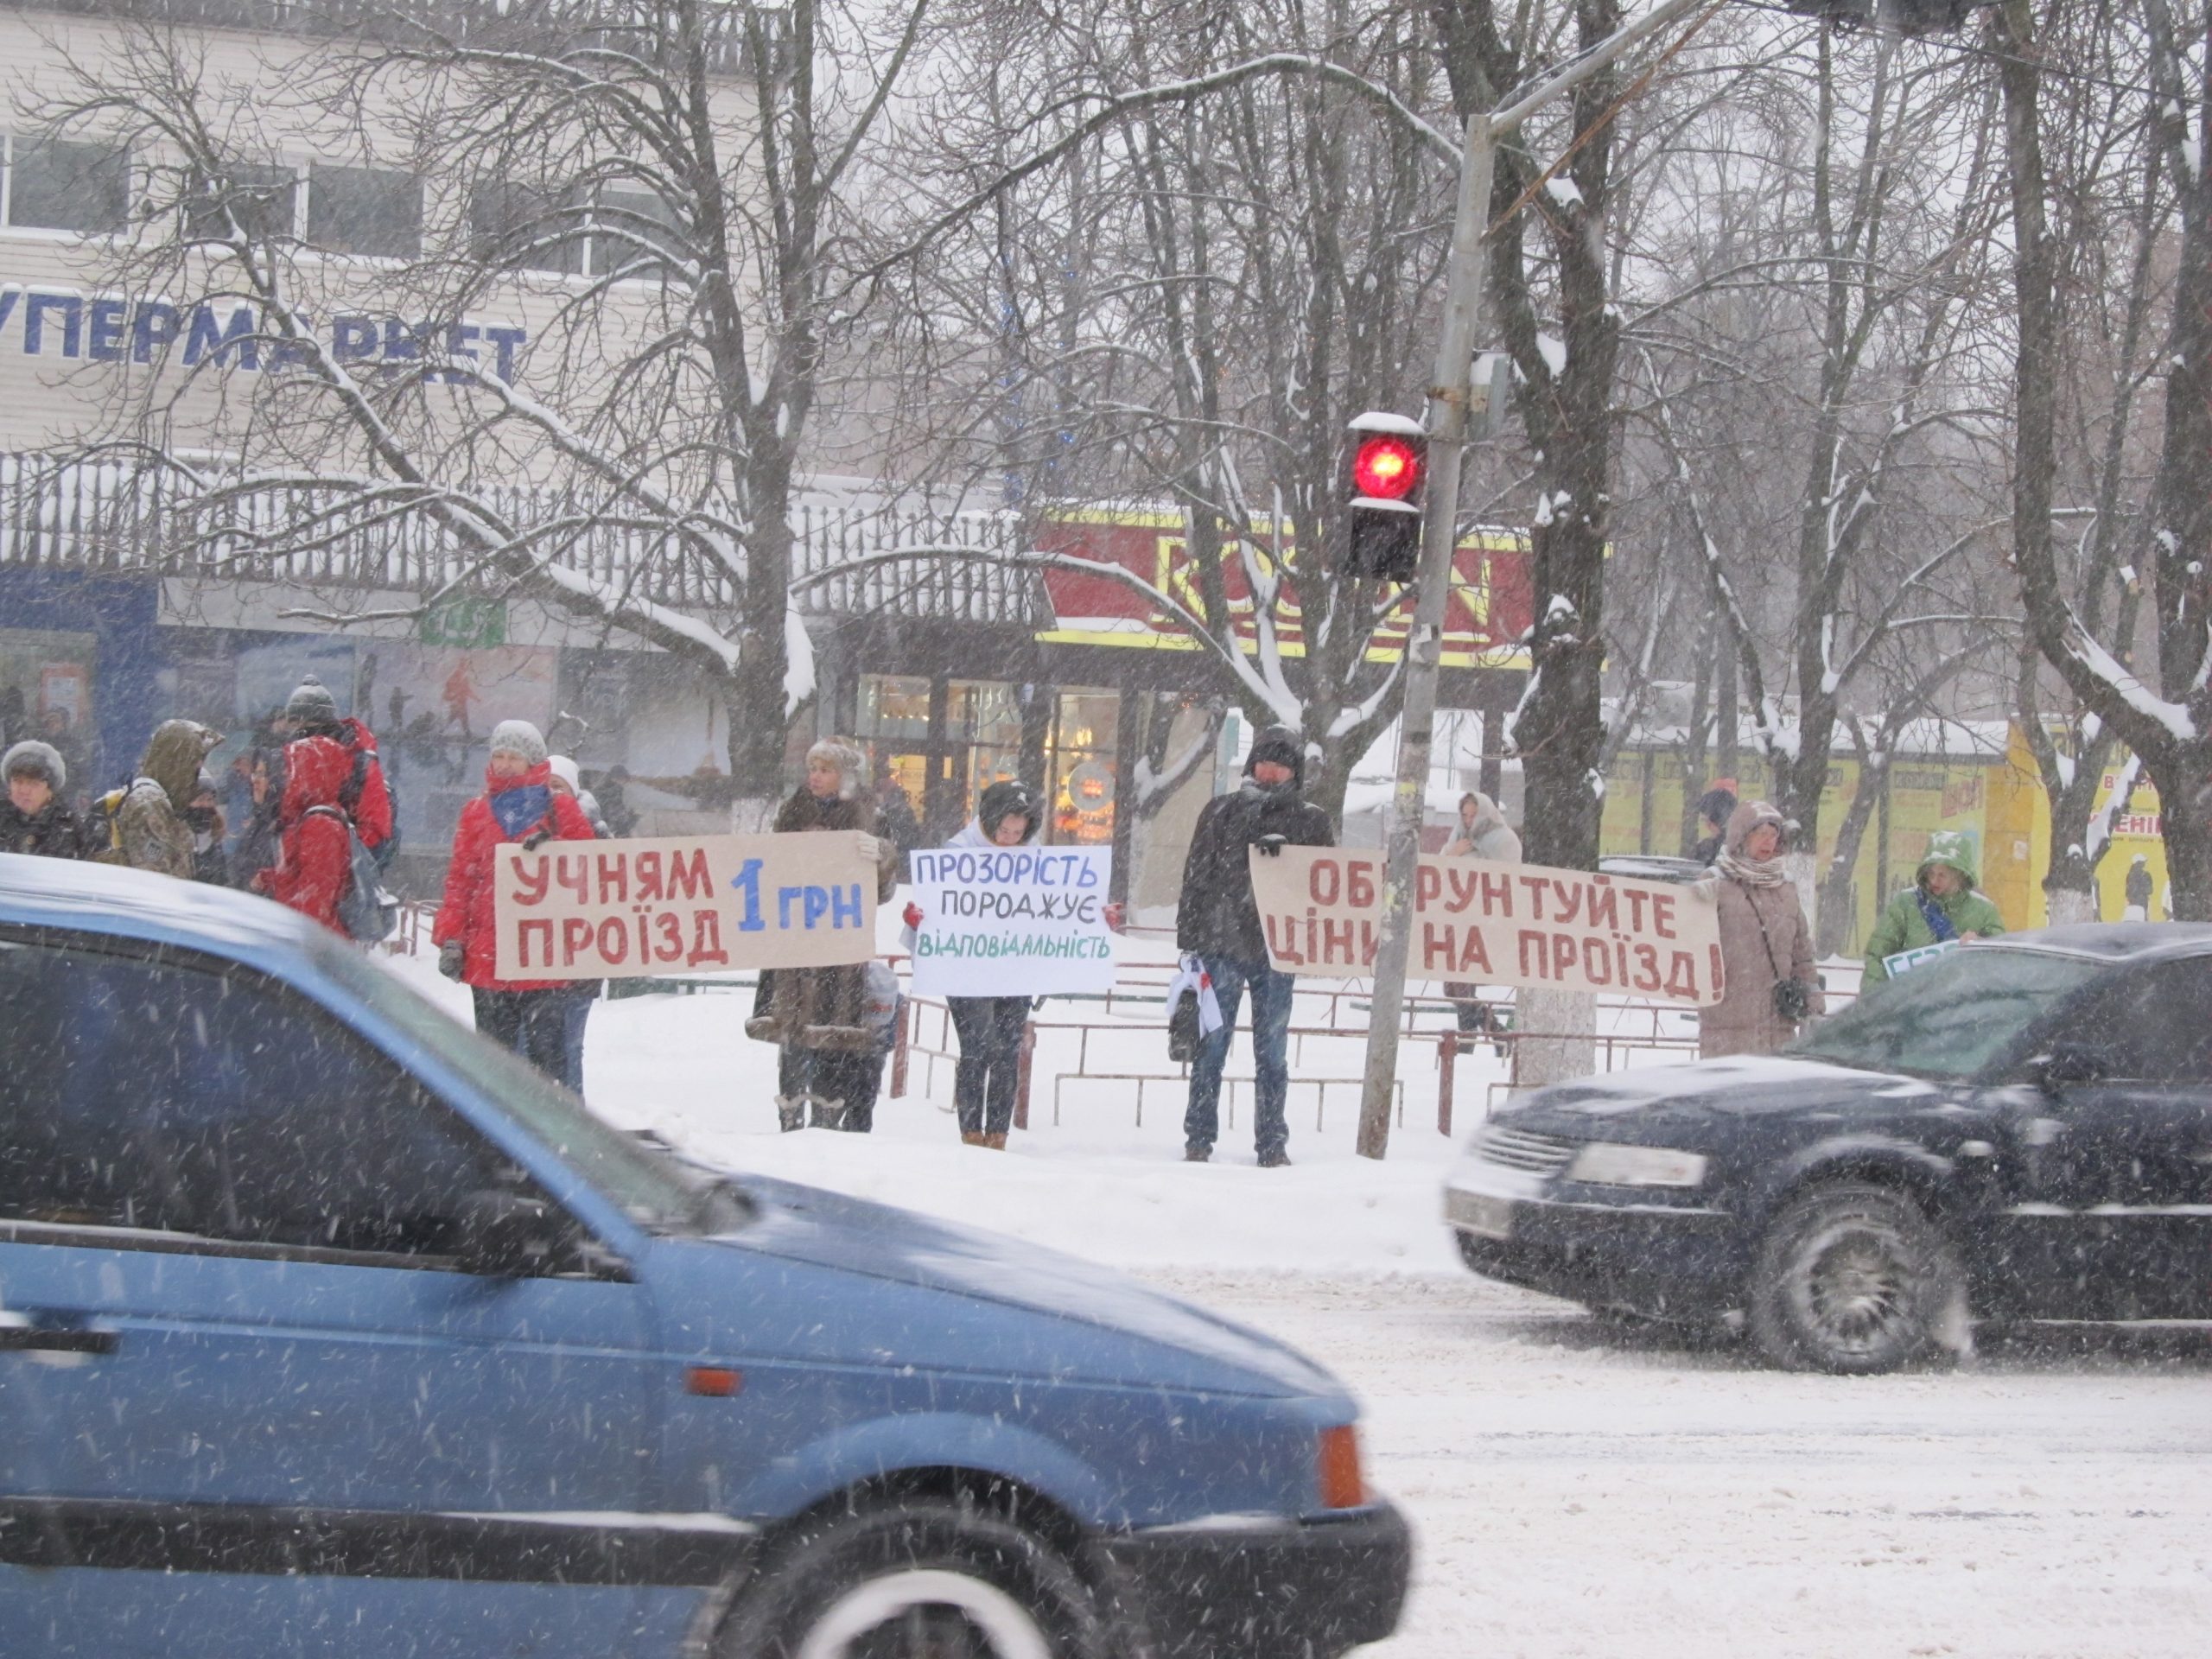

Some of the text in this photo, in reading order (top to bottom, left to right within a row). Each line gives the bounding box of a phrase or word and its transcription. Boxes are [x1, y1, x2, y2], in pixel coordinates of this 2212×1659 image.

[511, 848, 715, 906] УЧНЯМ
[730, 858, 863, 932] 1 ГРН
[917, 849, 1098, 888] ПРОЗОРІСТЬ
[1308, 858, 1676, 939] ОБРУНТУЙТЕ
[518, 905, 728, 969] ПРОЇЗД
[941, 890, 1098, 925] ПОРОДЖУЄ
[917, 929, 1111, 959] ВІДПОВІДАЛЬНІСТЬ
[1423, 921, 1494, 975] НА
[1517, 928, 1724, 1002] ПРОЇЗД!
